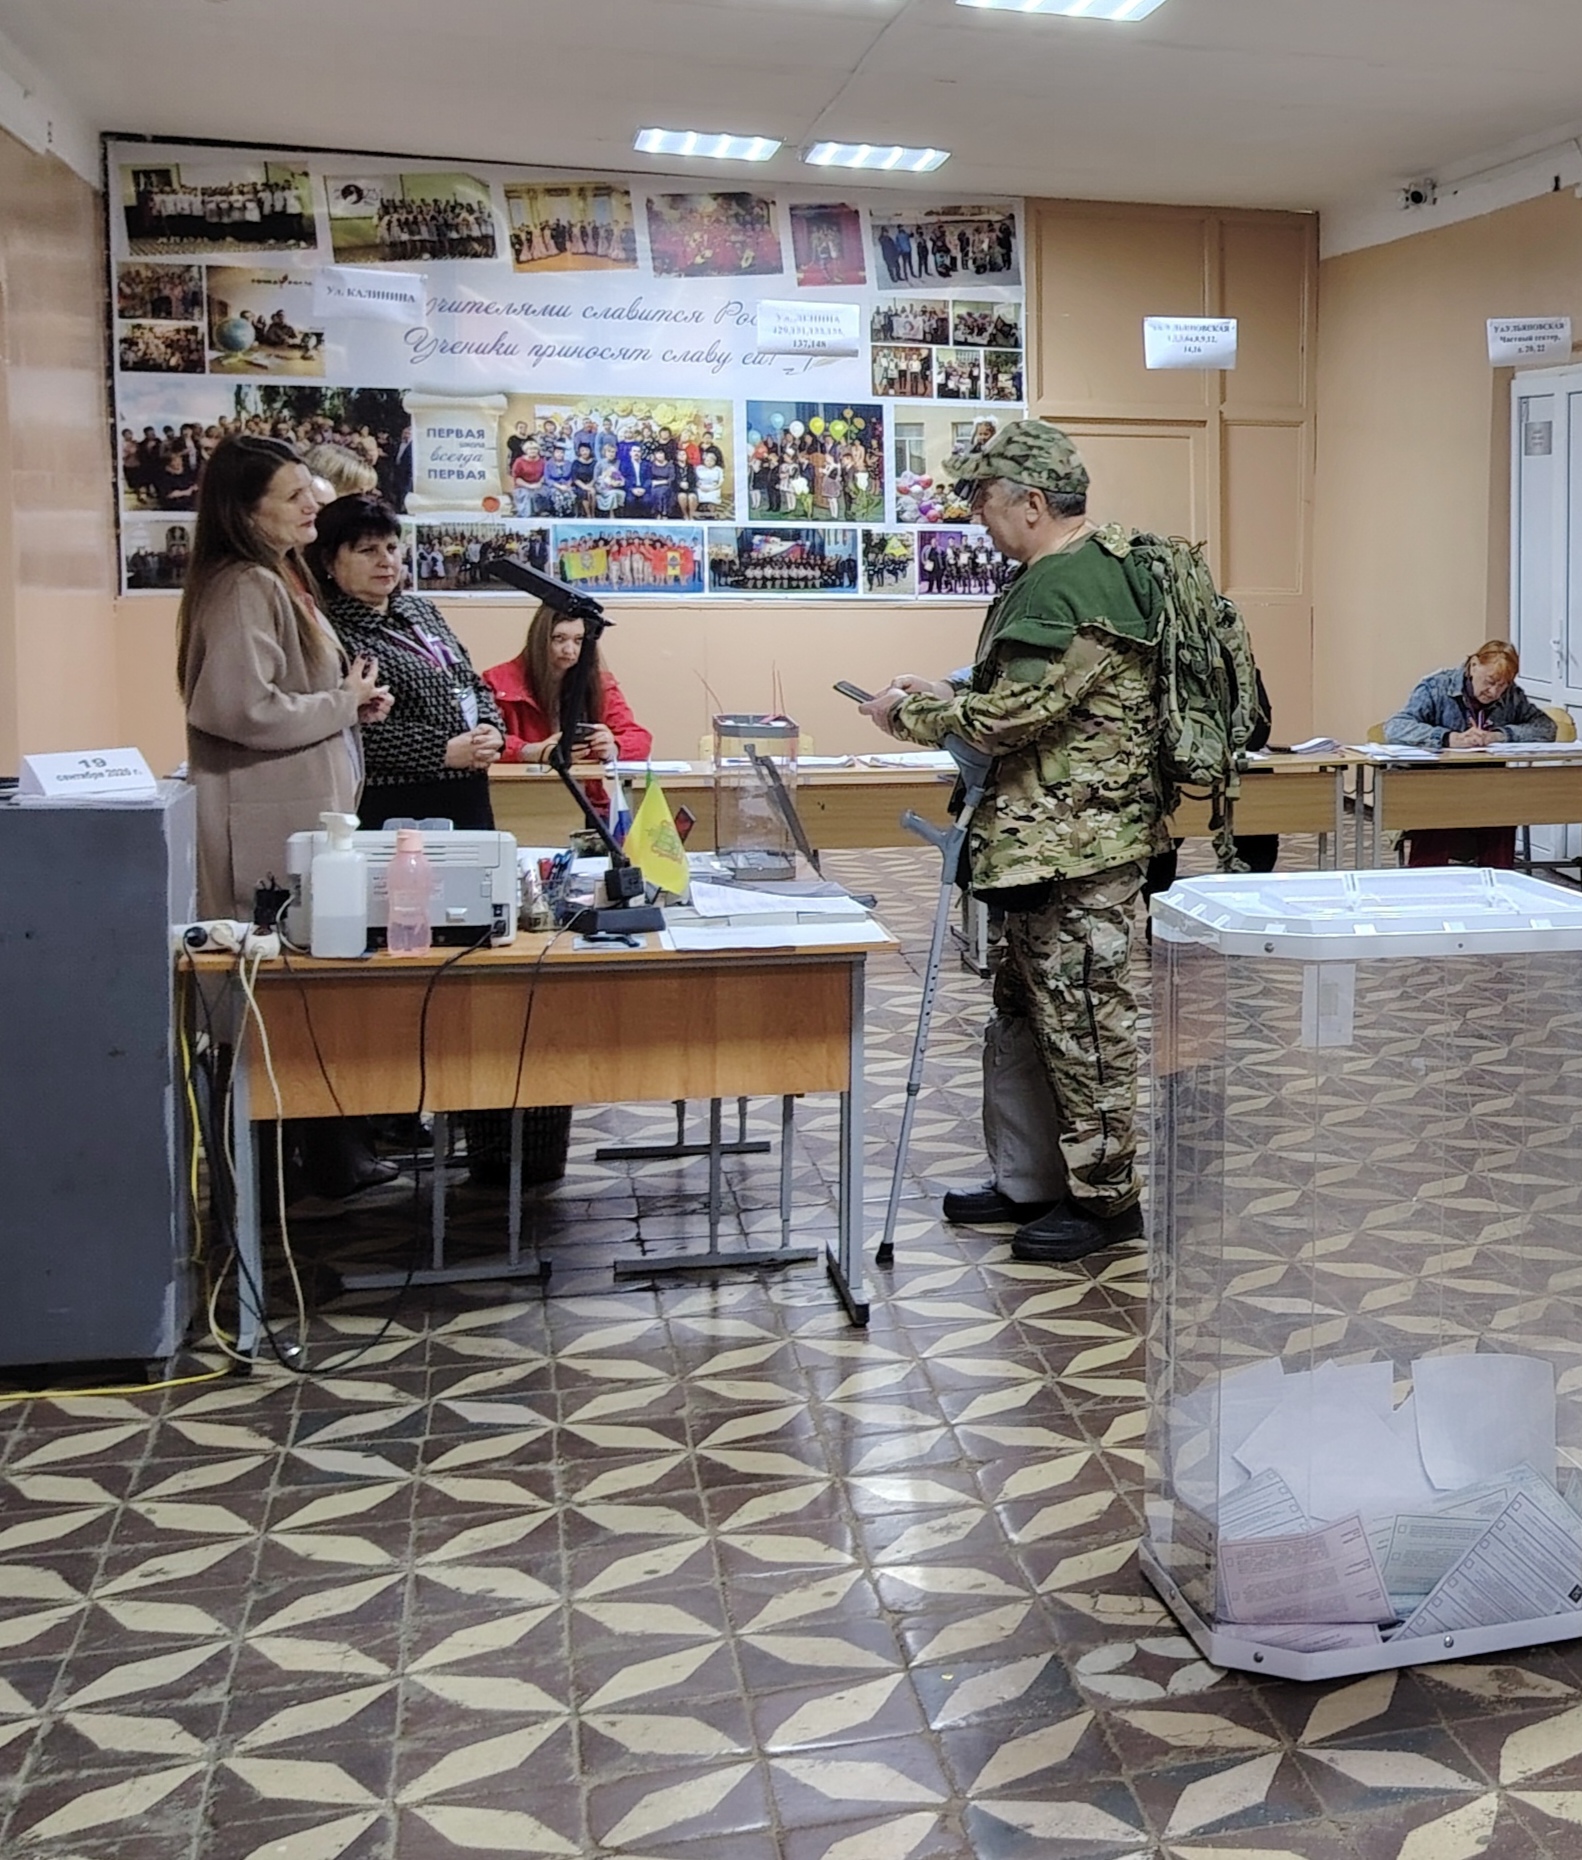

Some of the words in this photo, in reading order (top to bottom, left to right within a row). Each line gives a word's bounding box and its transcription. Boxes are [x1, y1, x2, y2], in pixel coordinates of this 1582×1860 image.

[347, 288, 416, 303] КАЛИНИНА
[581, 297, 705, 323] славится
[404, 326, 519, 364] Ученики
[527, 340, 652, 367] приносят
[661, 339, 733, 374] славу
[426, 428, 485, 439] ПЕРВАЯ
[427, 469, 486, 480] ПЕРВАЯ
[78, 757, 107, 768] 19
[56, 771, 105, 781] сентября
